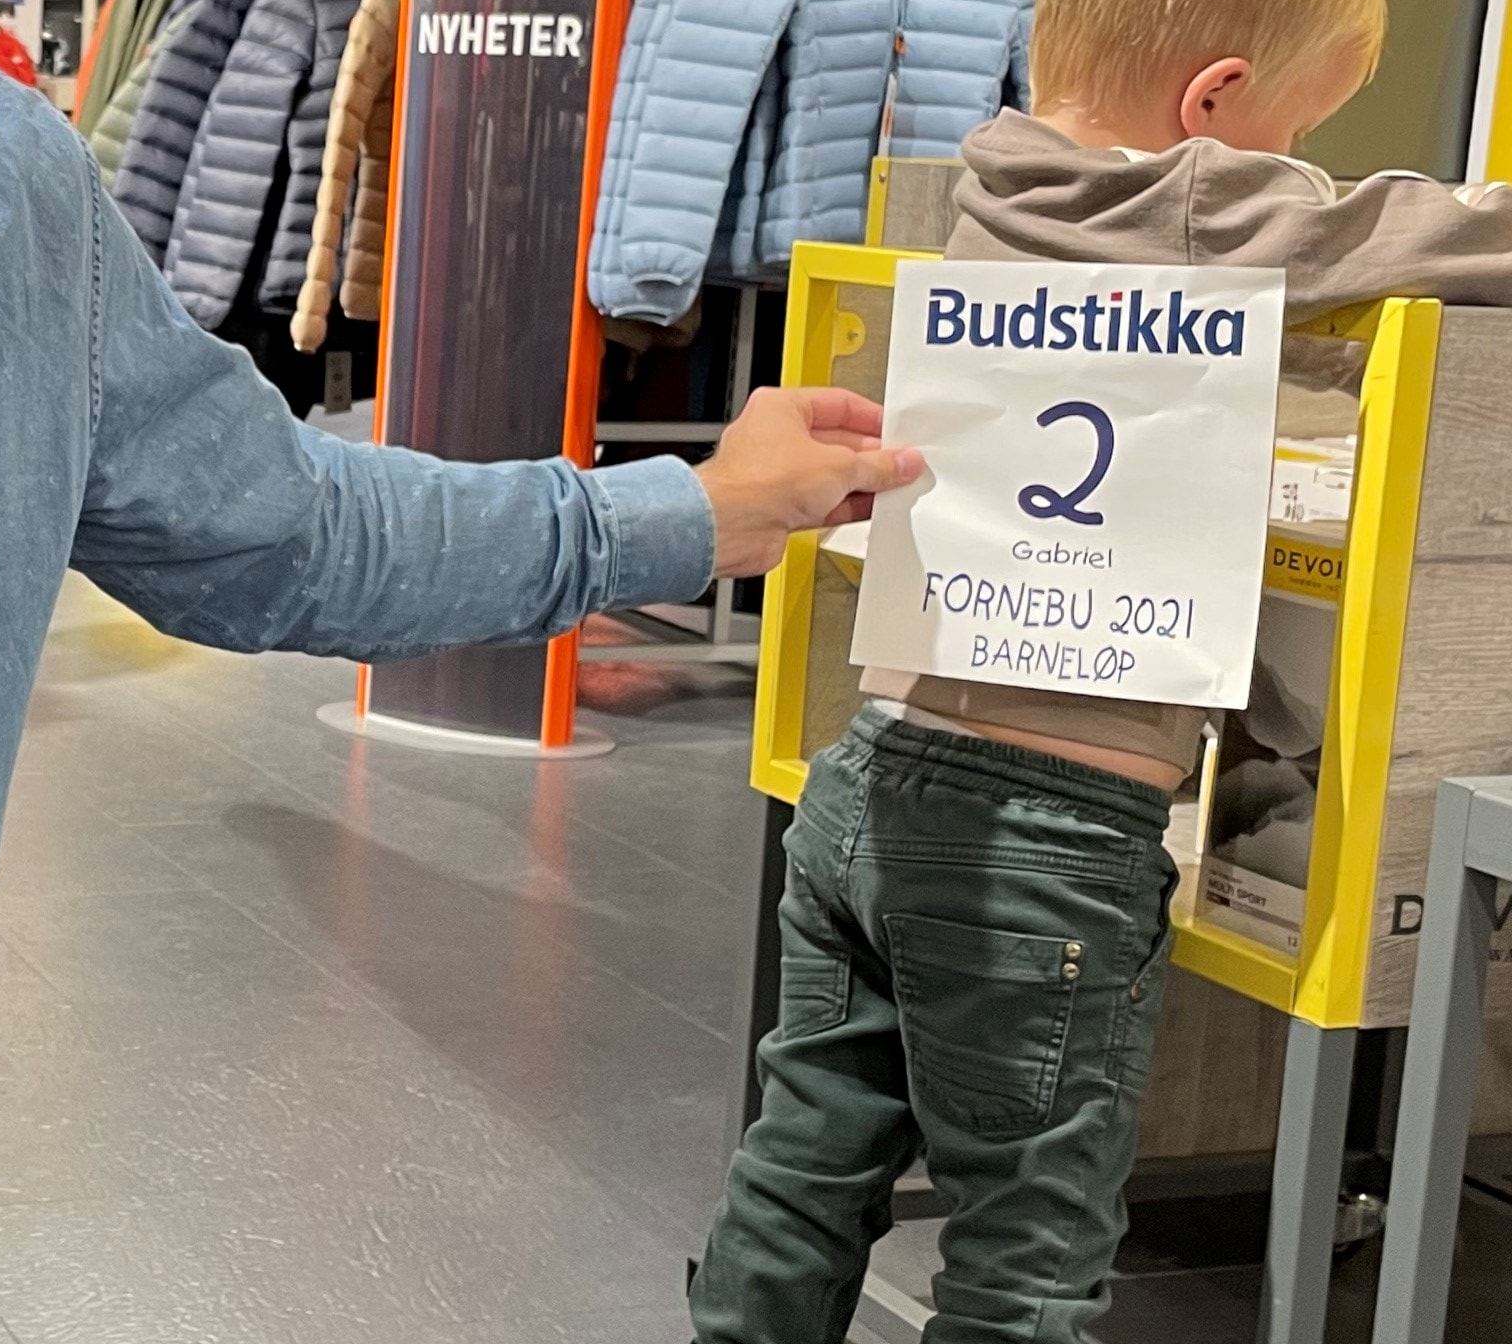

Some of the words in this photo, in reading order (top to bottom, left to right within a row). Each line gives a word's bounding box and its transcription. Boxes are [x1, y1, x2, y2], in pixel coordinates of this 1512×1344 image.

[417, 11, 584, 57] NYHETER
[925, 286, 1246, 357] Budstikka
[1017, 400, 1115, 526] 2
[1012, 541, 1113, 569] Gabriel
[922, 572, 1093, 630] FORNEBU
[1109, 595, 1194, 639] 2021
[970, 634, 1136, 684] BARNELØP
